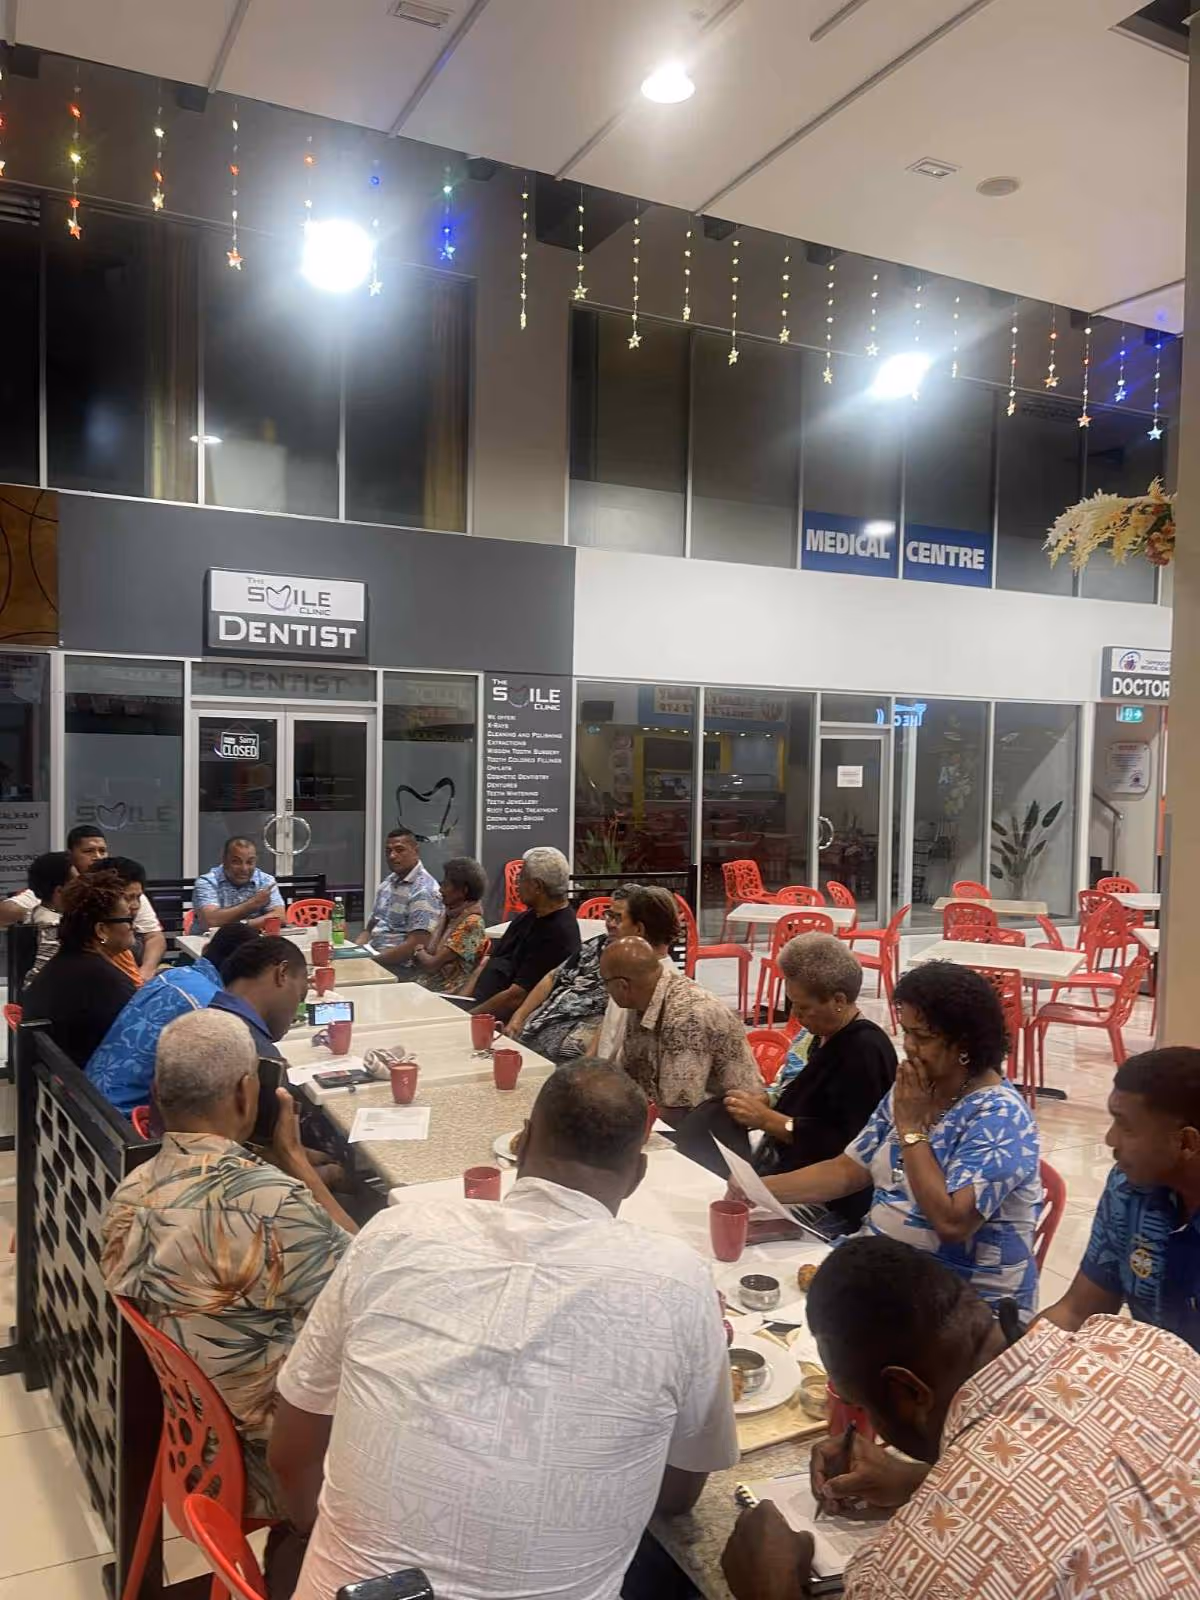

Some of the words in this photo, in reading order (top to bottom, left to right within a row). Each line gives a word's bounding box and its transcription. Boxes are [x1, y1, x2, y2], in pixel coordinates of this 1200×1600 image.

[806, 529, 890, 559] MEDICAL
[906, 540, 985, 570] CENTRE
[247, 577, 264, 585] THE
[299, 606, 331, 616] CLINIC
[219, 615, 357, 649] DENTIST
[1112, 677, 1170, 698] DOCTOR
[534, 703, 561, 711] CLINIC
[222, 744, 257, 757] CLOSED
